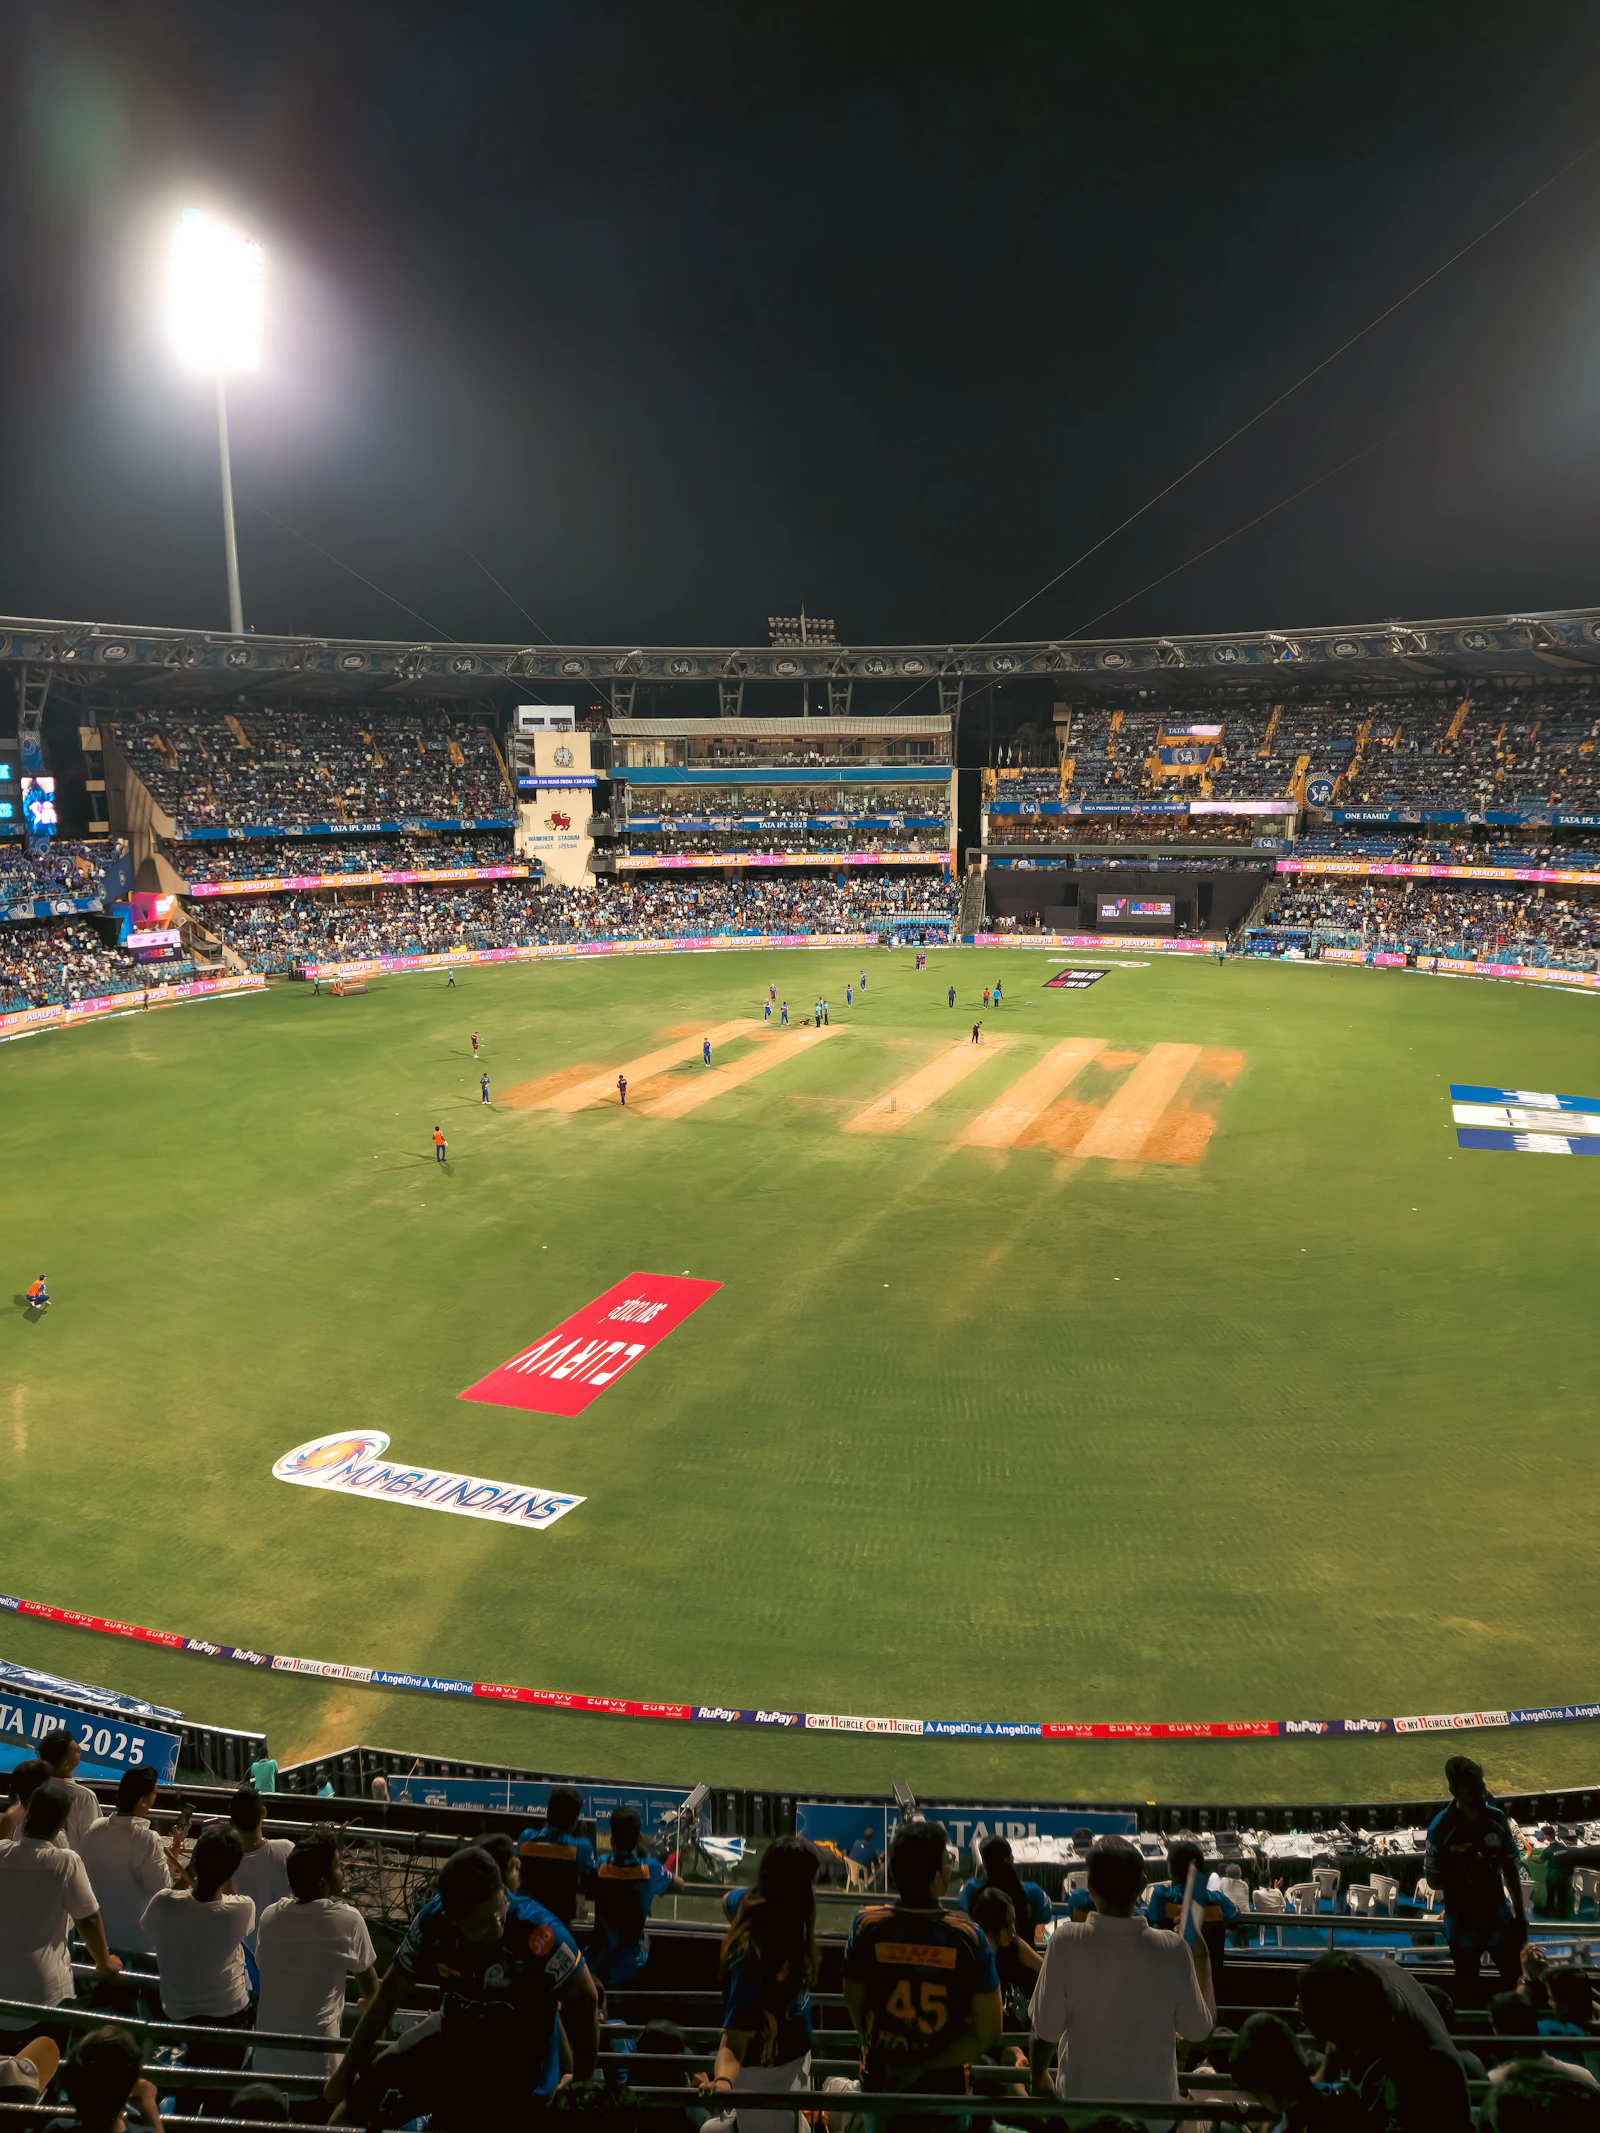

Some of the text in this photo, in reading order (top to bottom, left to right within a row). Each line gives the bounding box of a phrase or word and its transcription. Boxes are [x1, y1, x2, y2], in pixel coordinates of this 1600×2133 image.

[1559, 816, 1580, 824] TATA
[1323, 864, 1361, 873] JABALPUR
[341, 876, 373, 884] JABALPUR
[436, 872, 468, 880] JABALPUR
[241, 882, 275, 891] JABALPUR
[1131, 902, 1160, 911] MORE
[632, 942, 666, 950] JABALPUR
[729, 938, 761, 946] JABALPUR
[536, 947, 568, 956] JABALPUR
[438, 954, 471, 964] JABALPUR
[1427, 960, 1466, 969] JAALPUR
[338, 963, 372, 973] JABALPUR
[1545, 972, 1585, 982] JABALPUR
[132, 990, 168, 1004] JABLPUR
[25, 1008, 62, 1022] JABALPUR
[324, 1461, 579, 1522] MUMBAI INDIANS
[24, 1602, 54, 1613] CURVV
[64, 1612, 94, 1623] CURVV
[104, 1621, 135, 1632] CURVV
[146, 1631, 178, 1641] CURVV
[187, 1639, 218, 1656] RuPay
[232, 1649, 264, 1665] RuPay
[381, 1672, 421, 1688] AngelOne
[432, 1680, 472, 1693] AngelOne
[481, 1685, 519, 1694] CURVV
[533, 1692, 572, 1701] CURVV
[587, 1698, 627, 1708] CURVV
[642, 1704, 683, 1713] CURVV
[698, 1708, 735, 1721] RuPay
[1520, 1710, 1563, 1723] AngelOne
[1575, 1705, 1600, 1718] Angel
[755, 1711, 792, 1726] RuPay
[936, 1723, 982, 1735] AngelOne
[995, 1724, 1041, 1736] AngelOne
[1286, 1721, 1322, 1734] RuPay
[1344, 1719, 1381, 1732] RuPay
[0, 1704, 24, 1734] TA
[78, 1724, 146, 1764] 2025
[886, 1978, 948, 2035] 45
